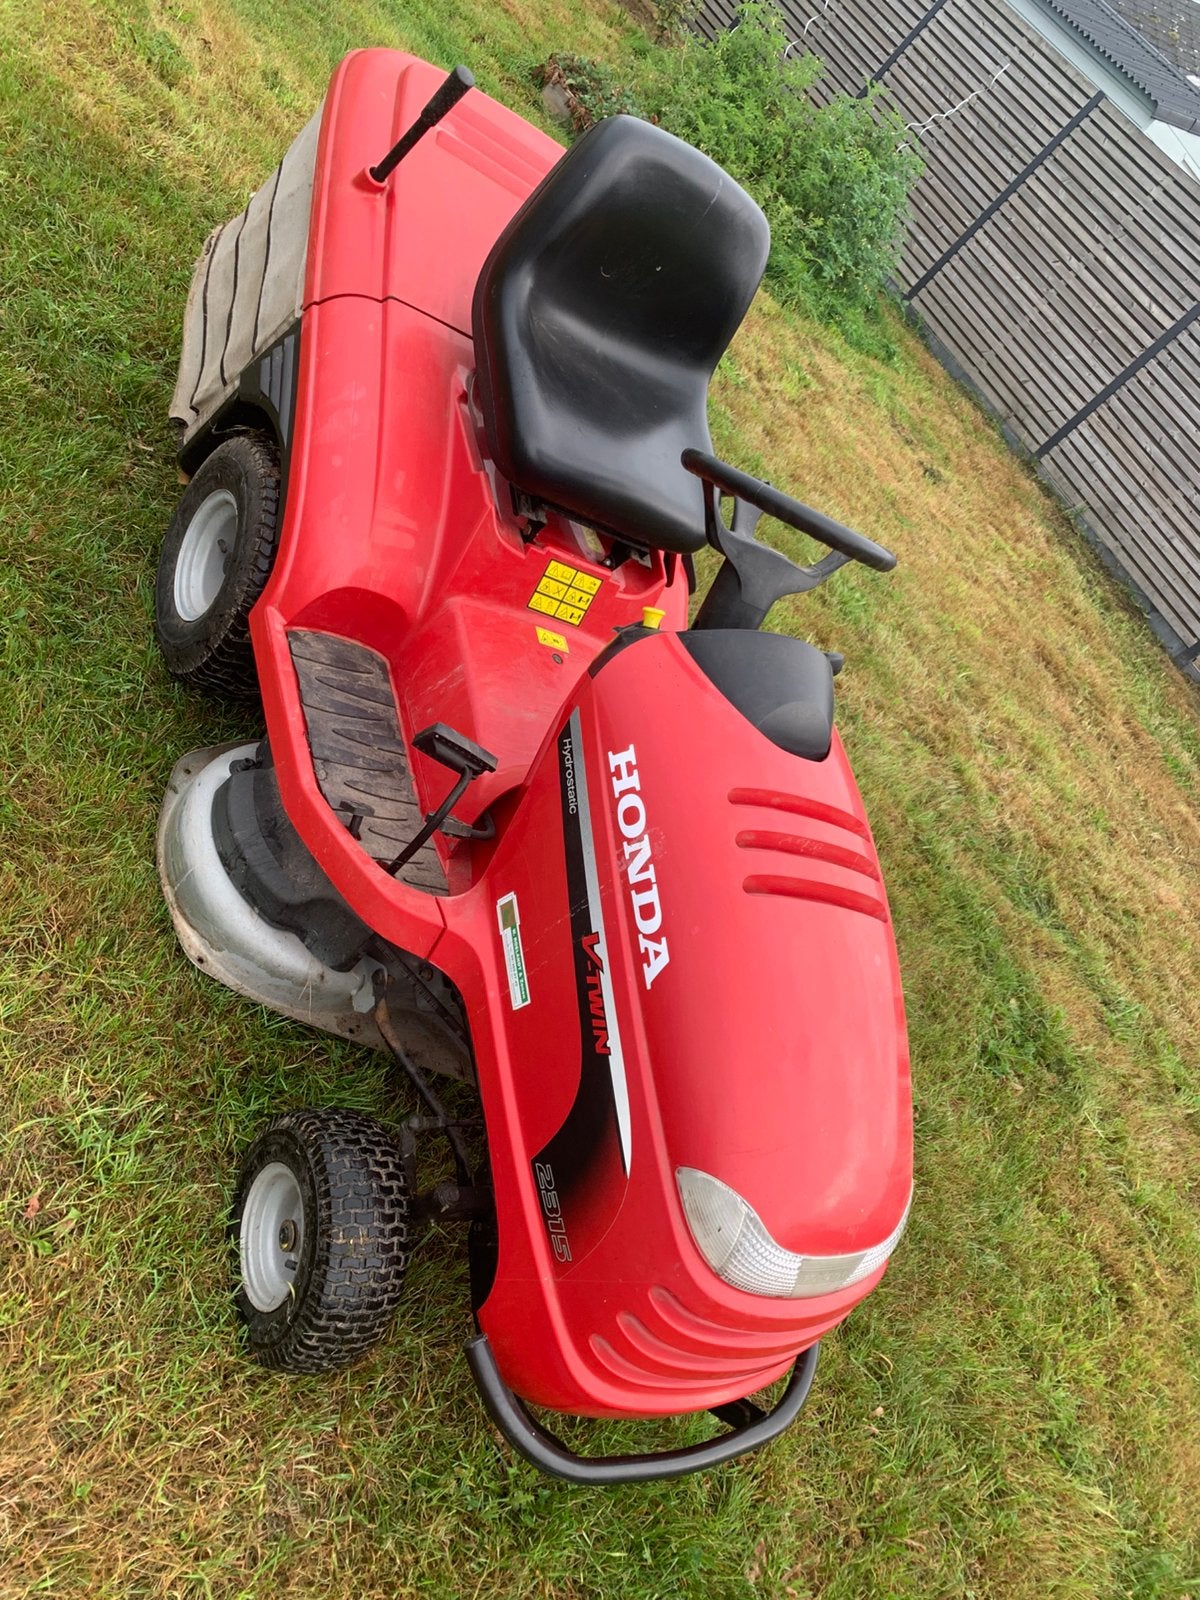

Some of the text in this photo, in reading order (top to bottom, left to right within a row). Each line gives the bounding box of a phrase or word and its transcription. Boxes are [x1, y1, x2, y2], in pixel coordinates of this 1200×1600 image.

[562, 738, 578, 815] Hydrostatic
[607, 744, 671, 990] HONDA
[581, 931, 612, 1056] V-TWIN
[535, 1162, 573, 1263] 2315
